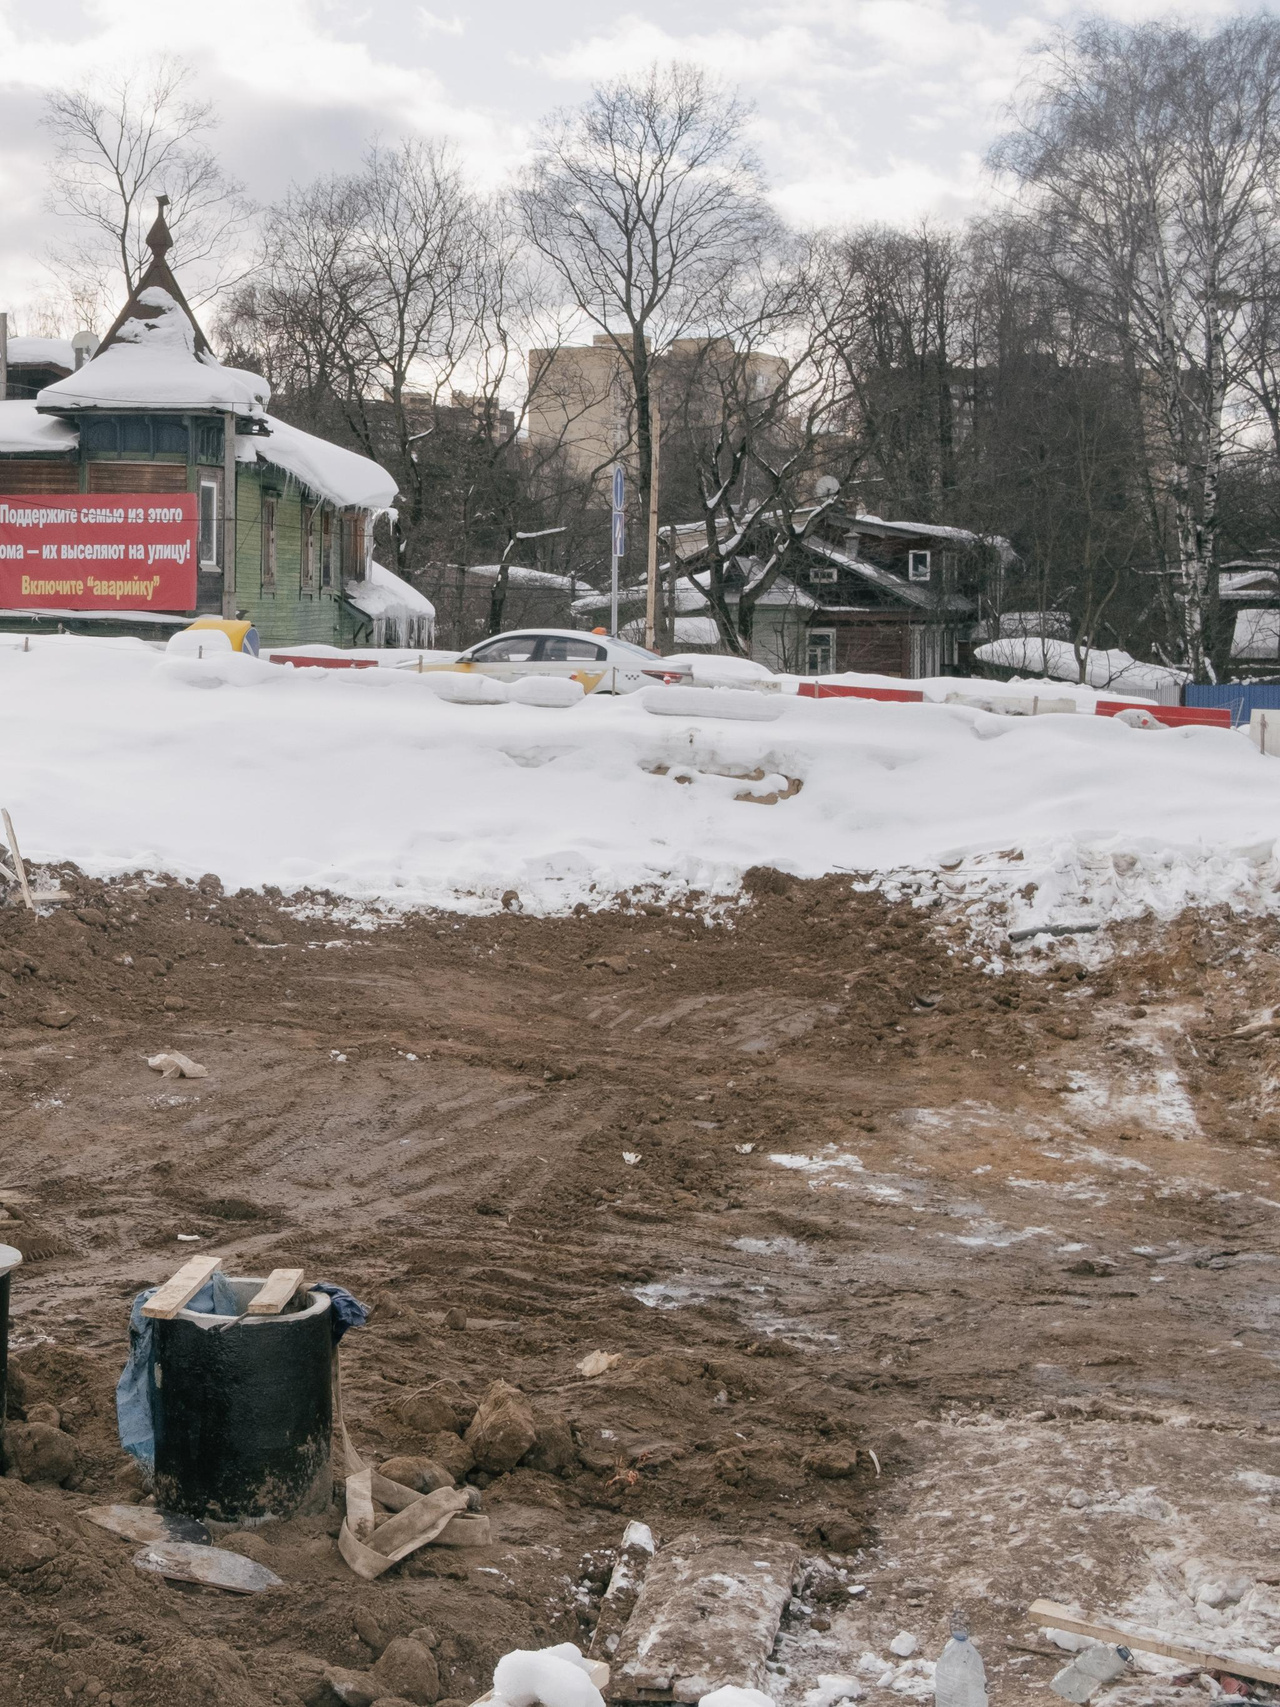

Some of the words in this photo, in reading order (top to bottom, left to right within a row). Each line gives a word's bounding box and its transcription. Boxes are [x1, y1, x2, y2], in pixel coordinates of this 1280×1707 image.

[0, 504, 78, 529] Поддержите
[80, 508, 125, 524] семью
[127, 508, 145, 524] из
[147, 508, 183, 523] этого
[42, 544, 58, 560] их
[60, 544, 126, 560] выселяют
[128, 544, 145, 560] на
[147, 539, 191, 565] улицу!
[21, 575, 84, 596] Включите
